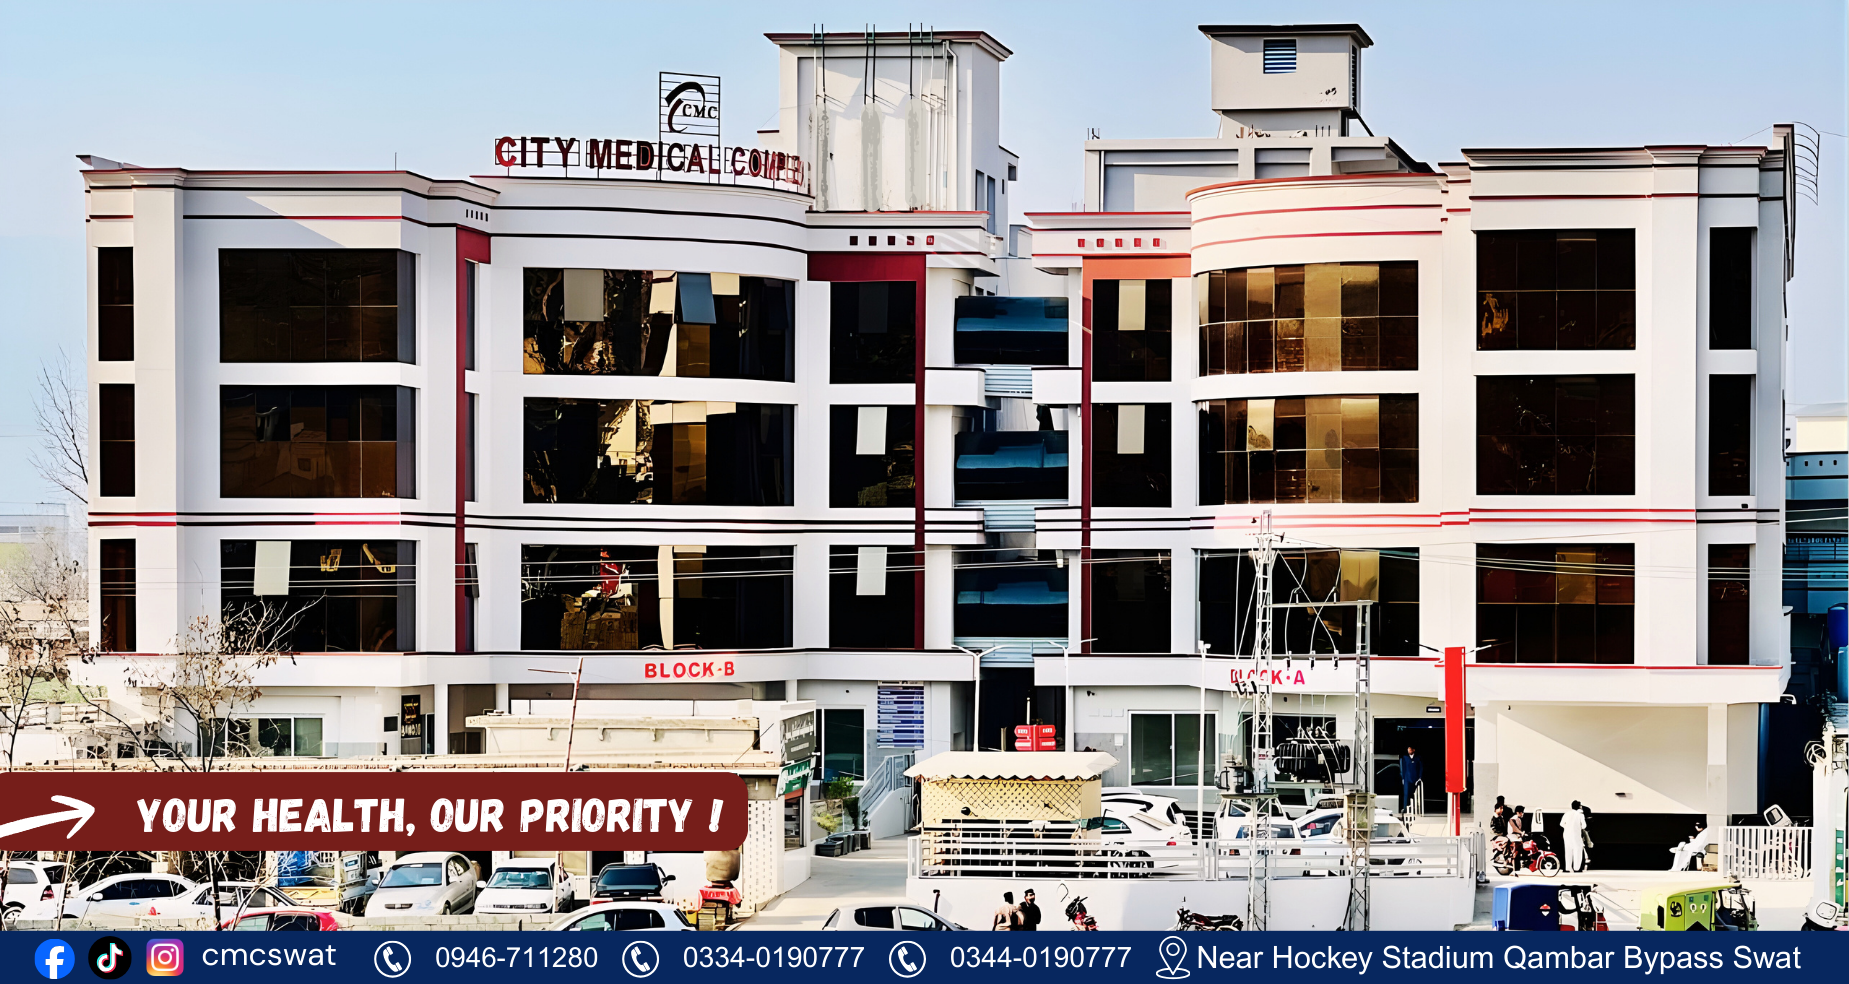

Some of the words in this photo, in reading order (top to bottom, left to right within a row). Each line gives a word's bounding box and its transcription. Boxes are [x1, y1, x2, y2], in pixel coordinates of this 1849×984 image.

[682, 103, 718, 119] CMC
[495, 136, 576, 167] CITY
[589, 138, 721, 174] MEDICAL
